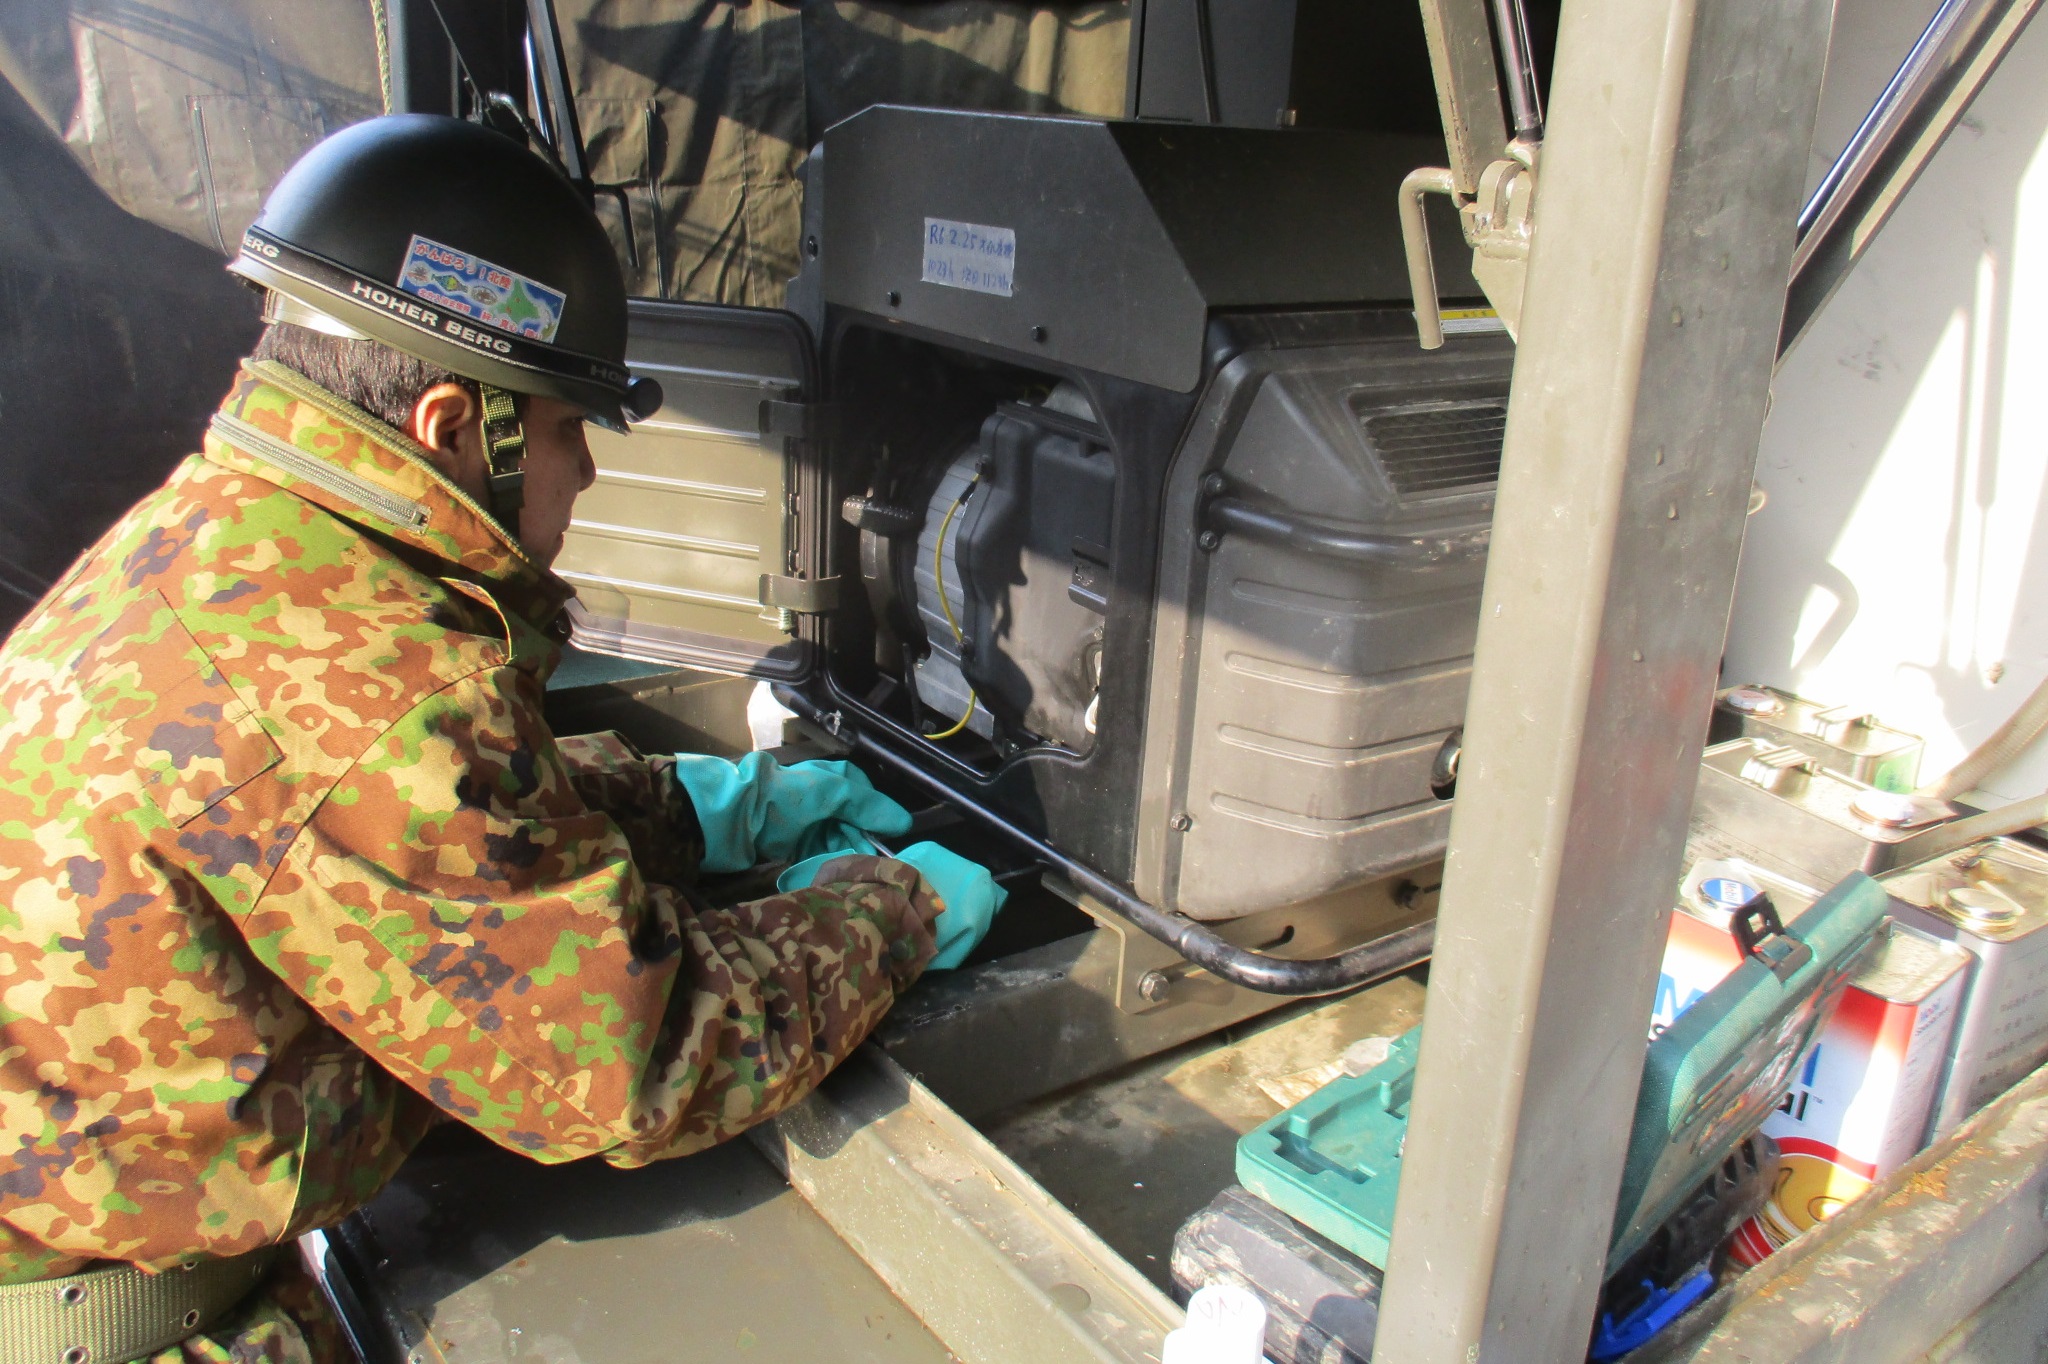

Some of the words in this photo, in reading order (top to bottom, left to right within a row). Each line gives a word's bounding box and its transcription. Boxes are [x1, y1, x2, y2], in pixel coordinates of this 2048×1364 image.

[244, 235, 280, 258] ERG
[351, 280, 439, 327] HOHER
[445, 319, 512, 353] BERG
